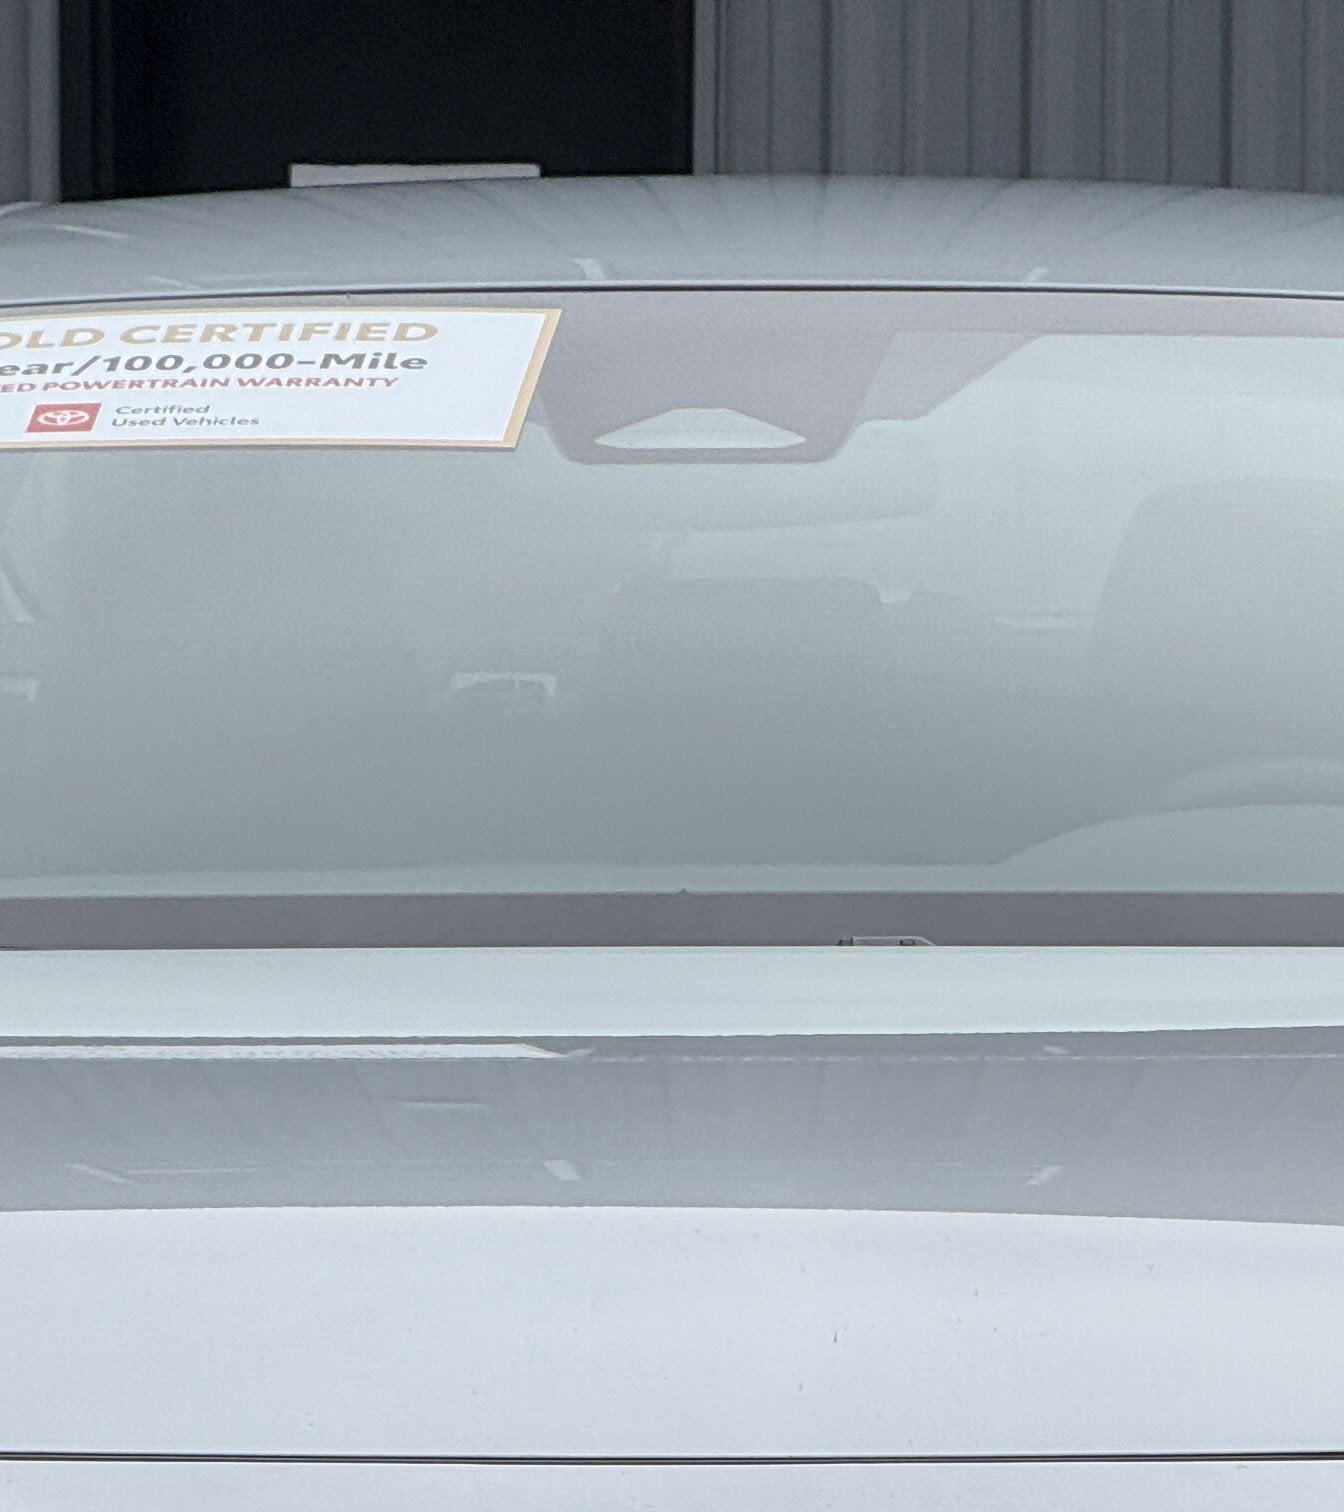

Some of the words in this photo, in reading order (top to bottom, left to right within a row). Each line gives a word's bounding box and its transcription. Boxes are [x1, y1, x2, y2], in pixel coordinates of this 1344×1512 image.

[119, 321, 439, 347] CERTIFIED
[42, 377, 231, 392] POWERTRAIN
[237, 376, 400, 389] WARRANTY
[115, 403, 211, 416] Certified
[111, 417, 167, 428] Used
[172, 416, 261, 427] Vehicles
